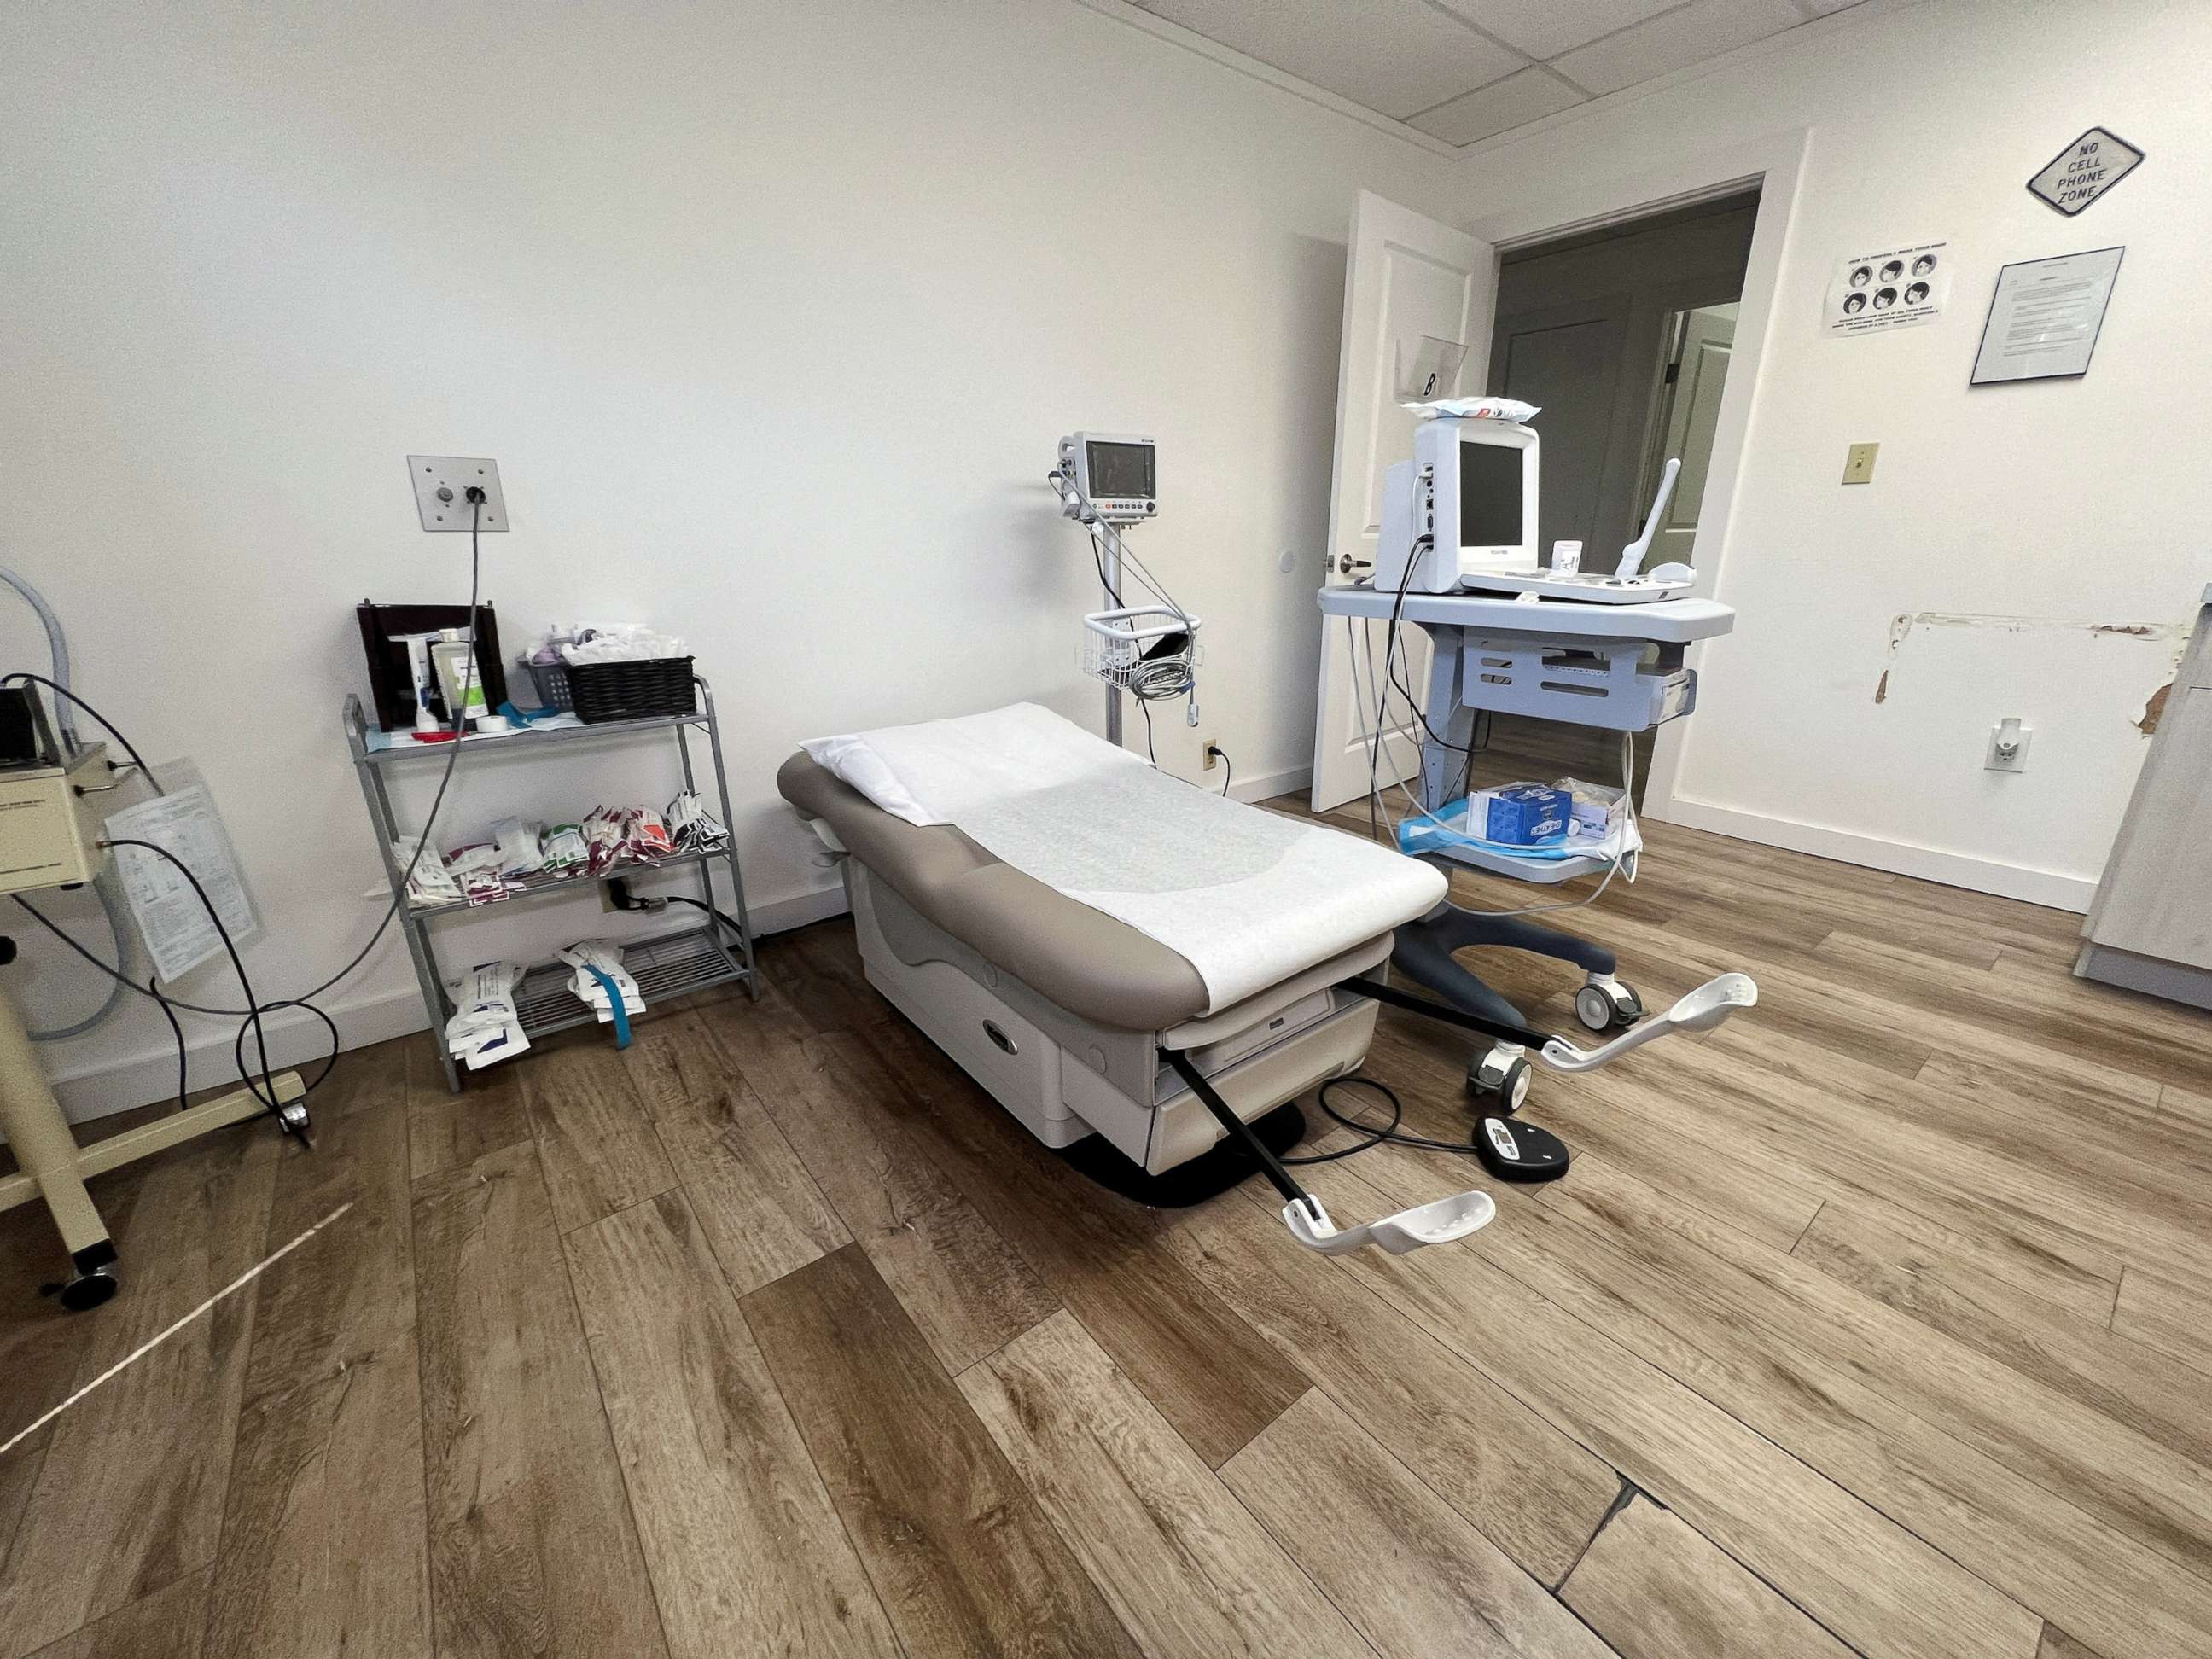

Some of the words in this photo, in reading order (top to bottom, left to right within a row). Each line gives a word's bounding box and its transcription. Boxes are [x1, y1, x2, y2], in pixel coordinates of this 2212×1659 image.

[2079, 142, 2099, 156] NO
[2068, 157, 2100, 173] CELL
[2057, 168, 2107, 189] PHONE
[2058, 185, 2097, 204] ZONE
[1423, 373, 1436, 396] B
